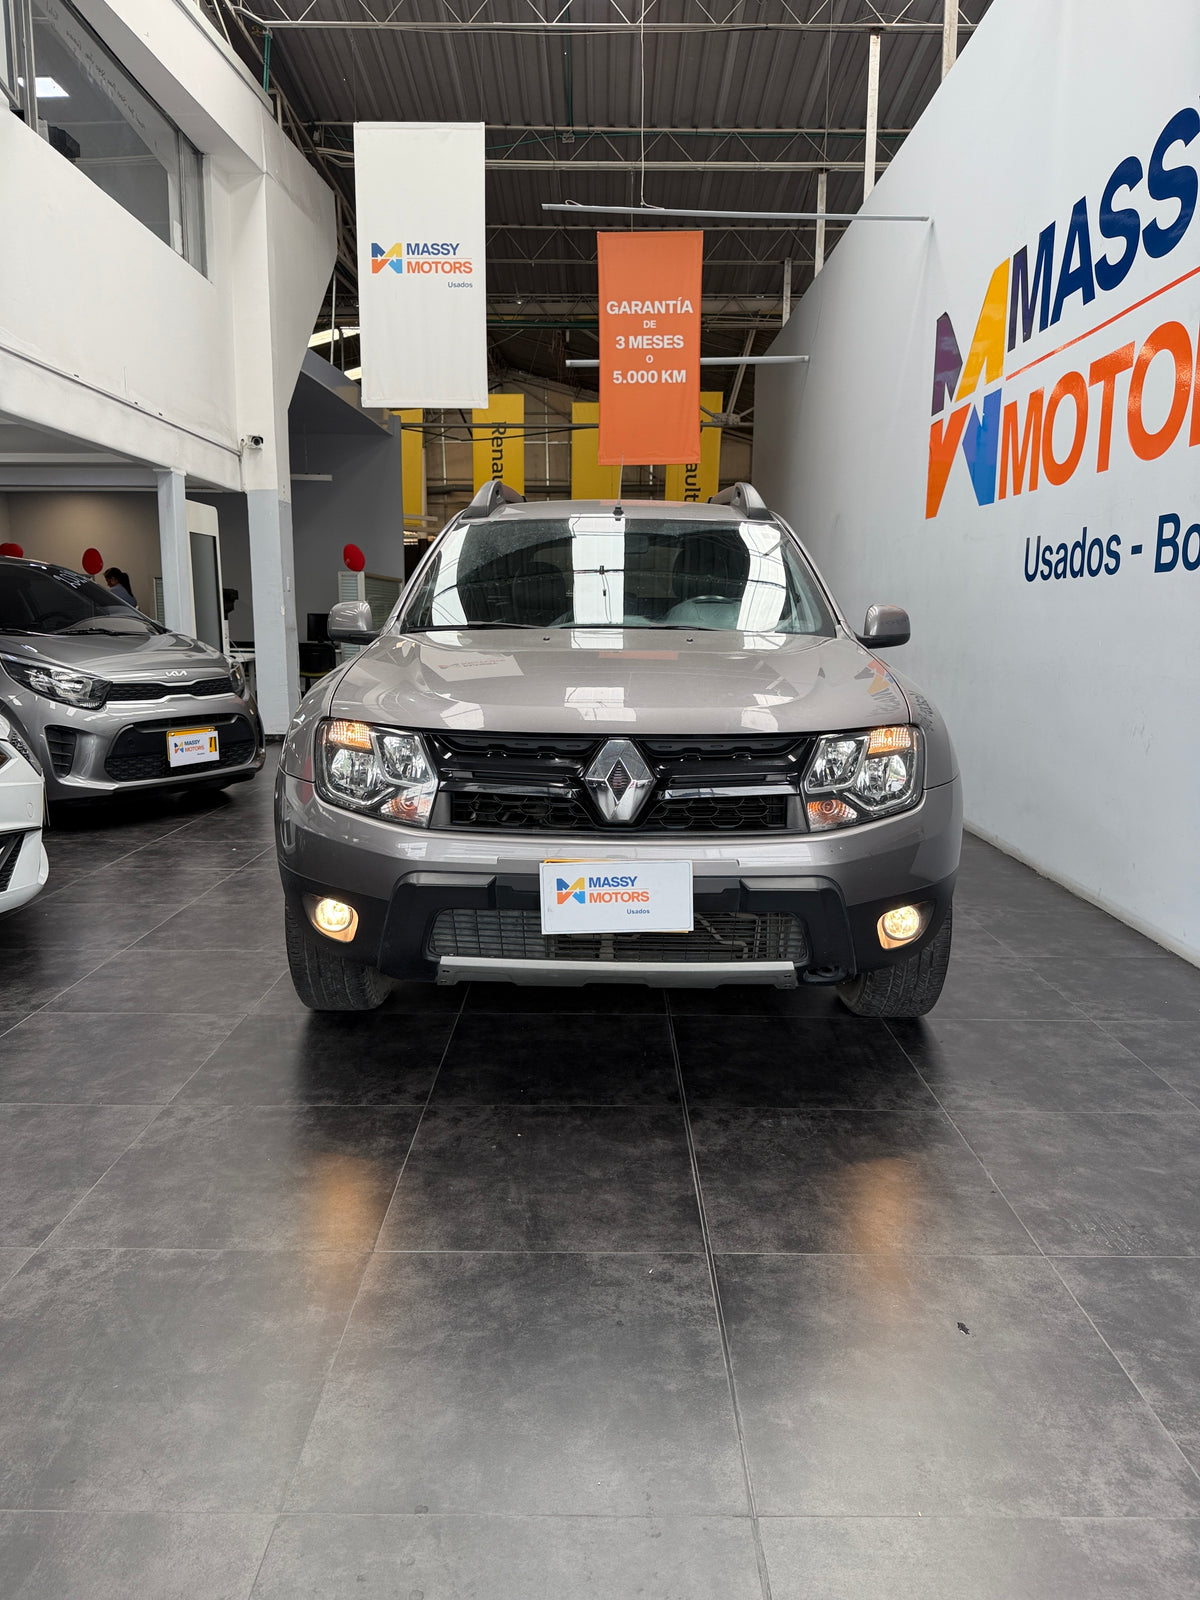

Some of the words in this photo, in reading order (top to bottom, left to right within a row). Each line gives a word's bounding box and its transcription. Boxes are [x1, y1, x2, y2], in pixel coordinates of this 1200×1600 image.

[406, 243, 460, 256] MASSY
[406, 261, 473, 274] MOTORS
[606, 296, 694, 315] GARANTÍA
[643, 320, 657, 328] DE
[615, 336, 625, 349] 3
[628, 335, 684, 349] MESES
[612, 370, 658, 384] 5.000
[661, 370, 687, 383] KM
[998, 320, 1200, 501] MOTO
[1024, 526, 1122, 583] Usados
[1154, 512, 1200, 573] Bo
[184, 745, 205, 753] MOTORS
[588, 876, 638, 888] MASSY
[589, 891, 650, 904] MOTORS
